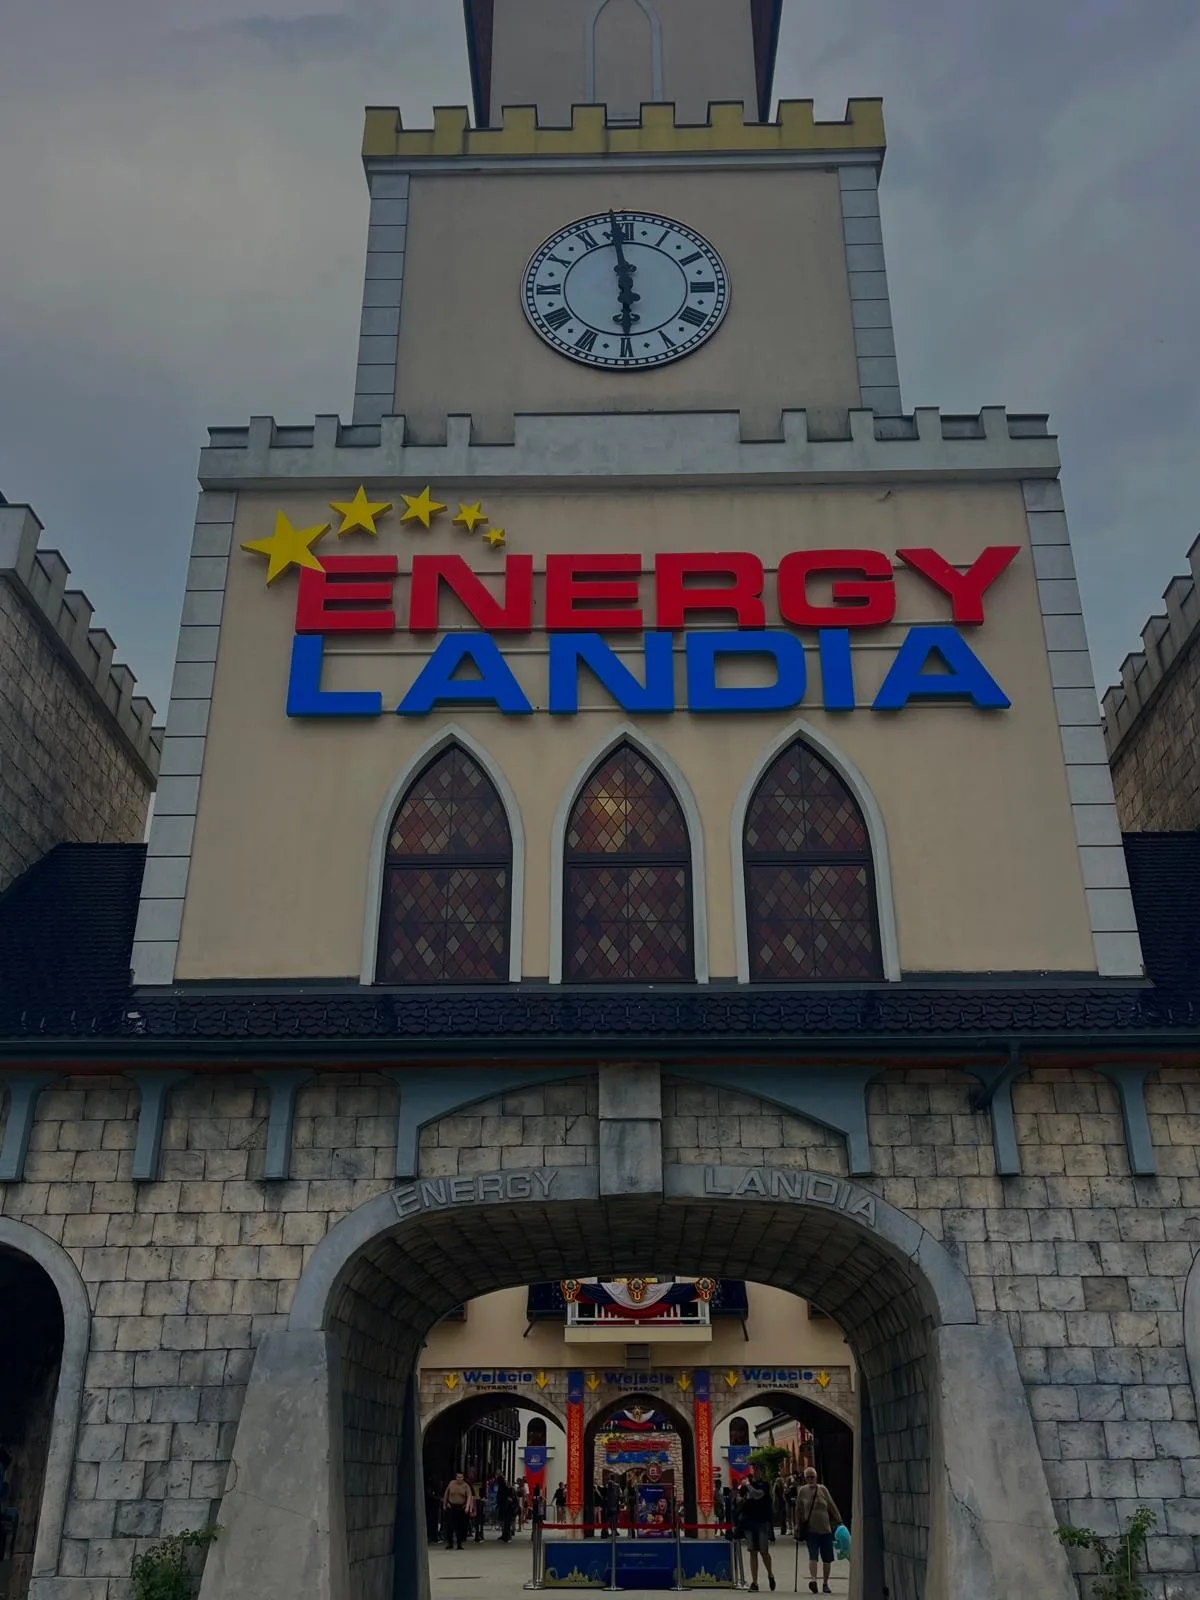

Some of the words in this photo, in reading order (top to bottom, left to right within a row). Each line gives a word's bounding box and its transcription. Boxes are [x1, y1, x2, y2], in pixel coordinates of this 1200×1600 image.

[294, 545, 1021, 634] ENERGY
[286, 626, 1011, 718] LANDIA
[391, 1170, 558, 1217] ENERGY
[705, 1166, 876, 1227] LANDIA
